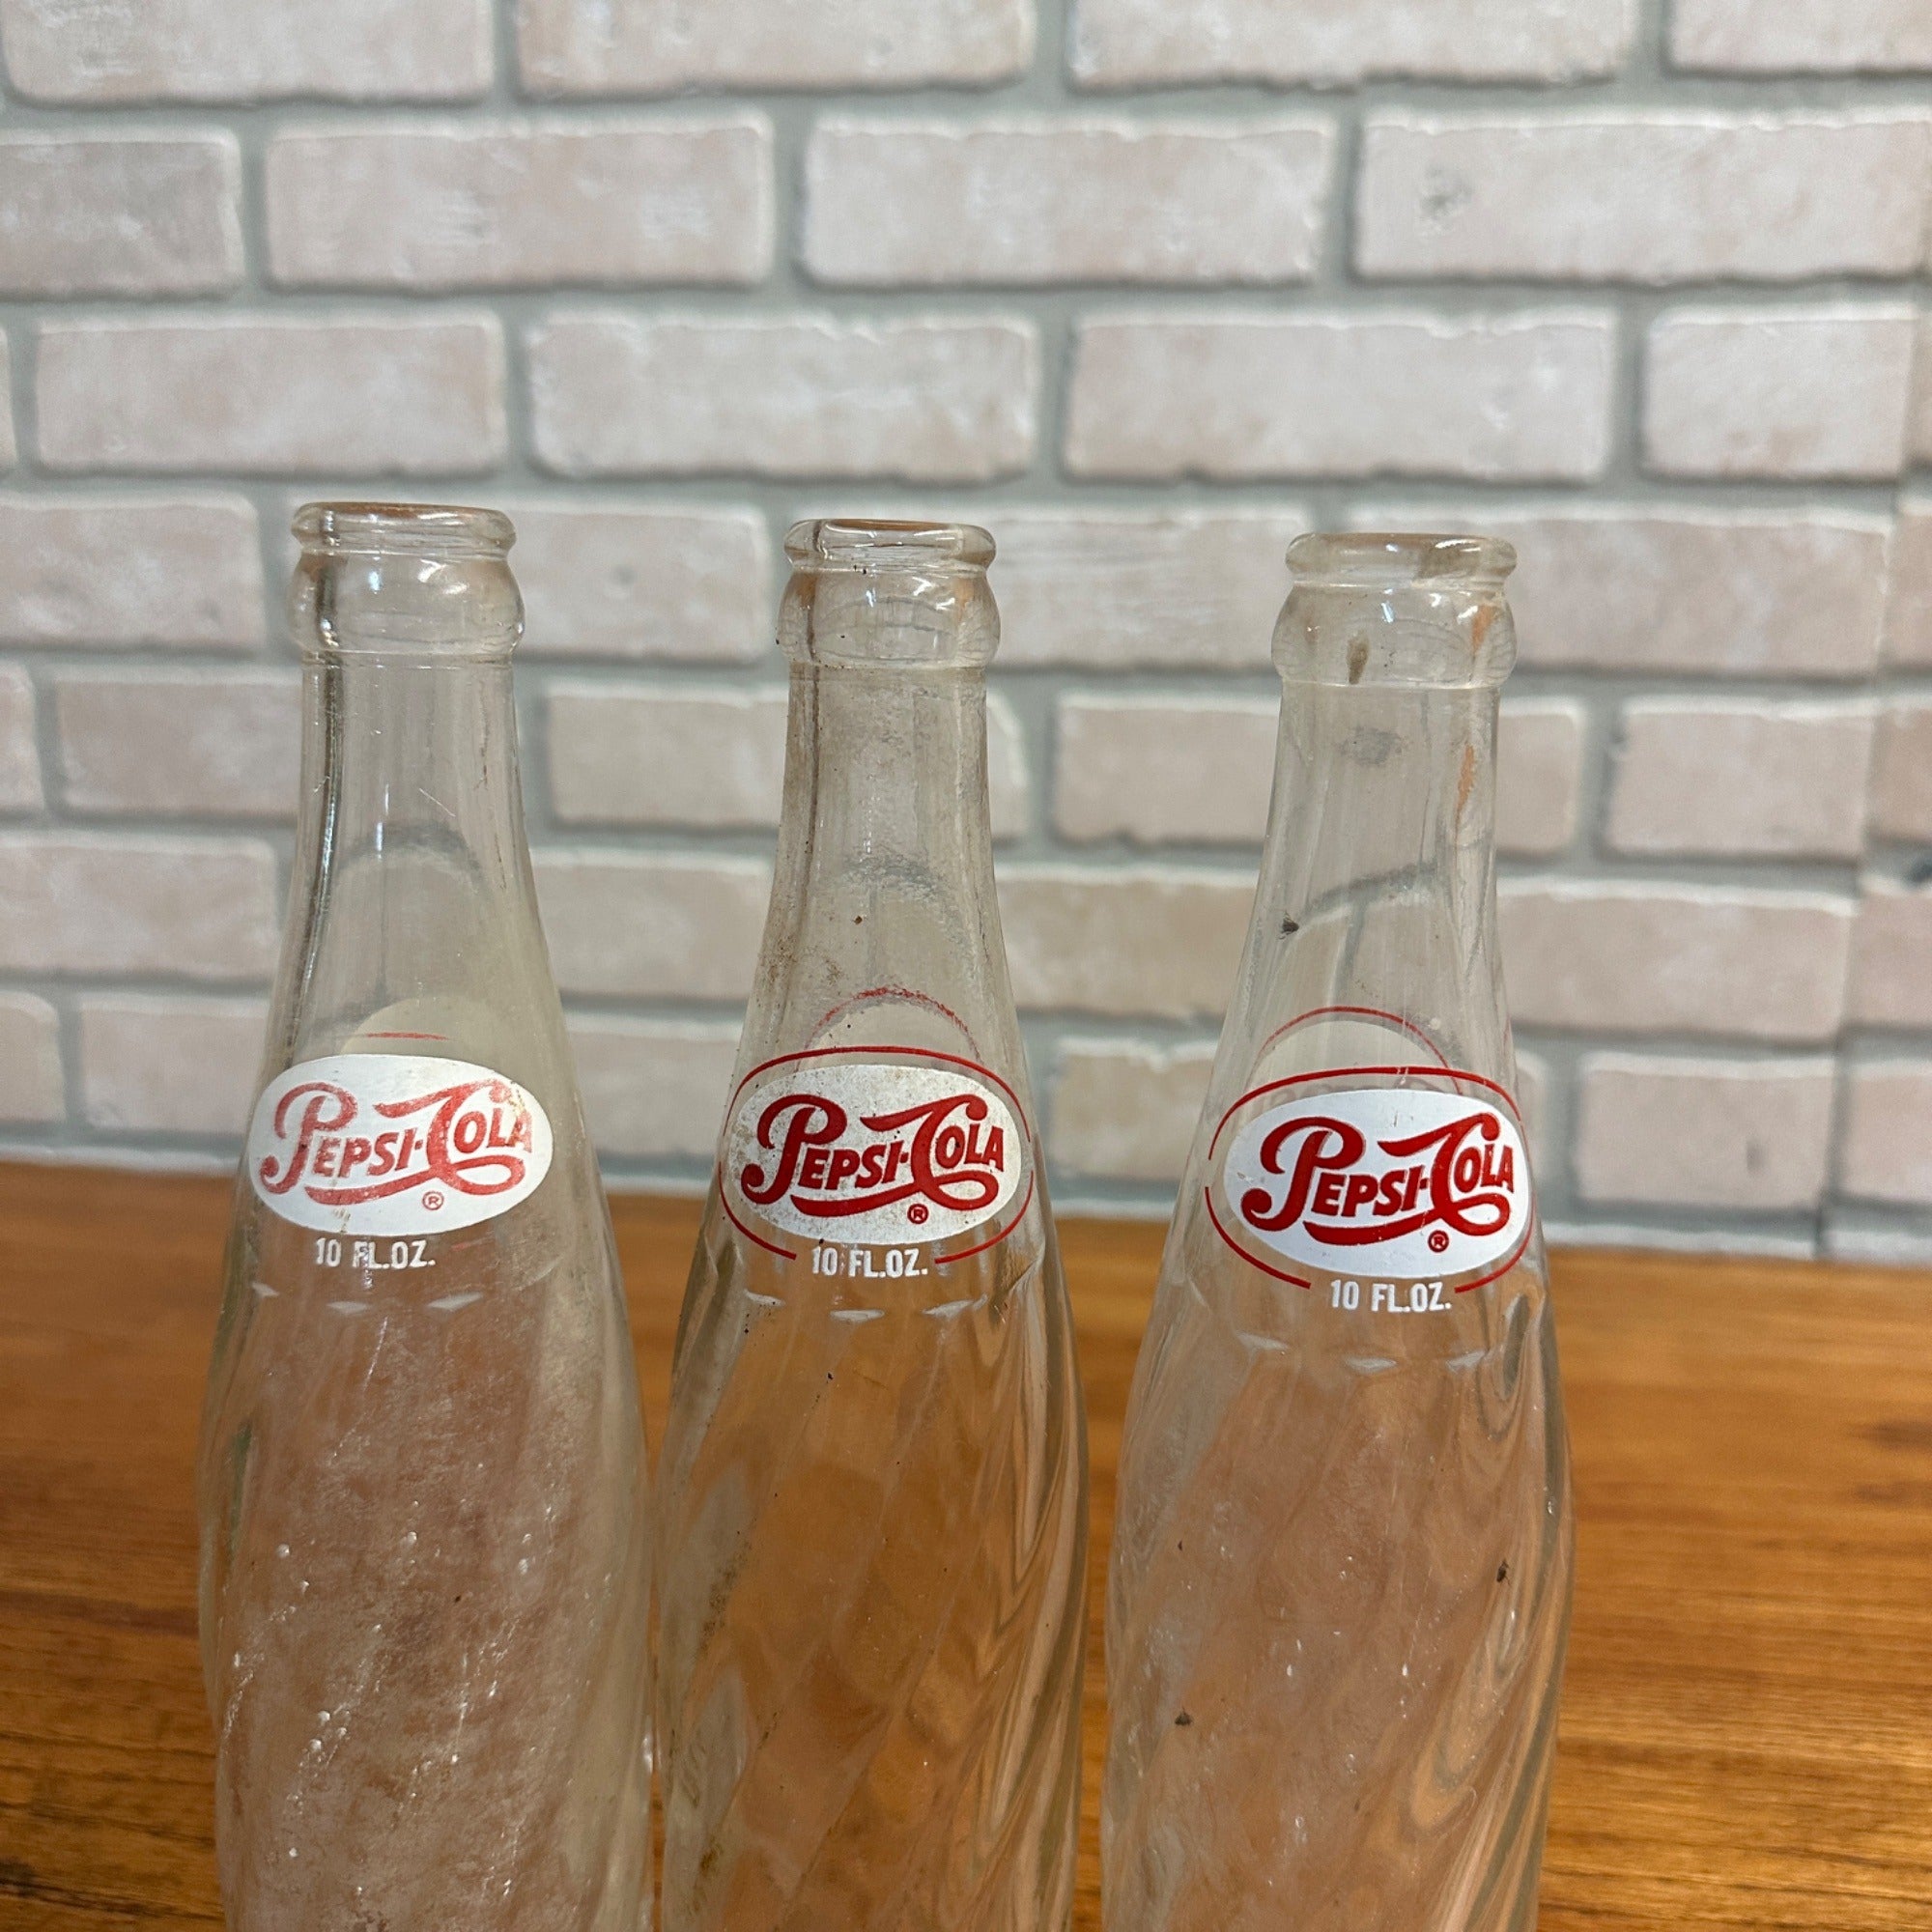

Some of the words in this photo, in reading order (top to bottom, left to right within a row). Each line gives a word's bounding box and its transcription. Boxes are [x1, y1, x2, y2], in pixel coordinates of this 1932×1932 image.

[315, 1237, 342, 1267] 10
[811, 1246, 838, 1276] 10
[1330, 1279, 1359, 1310] 10
